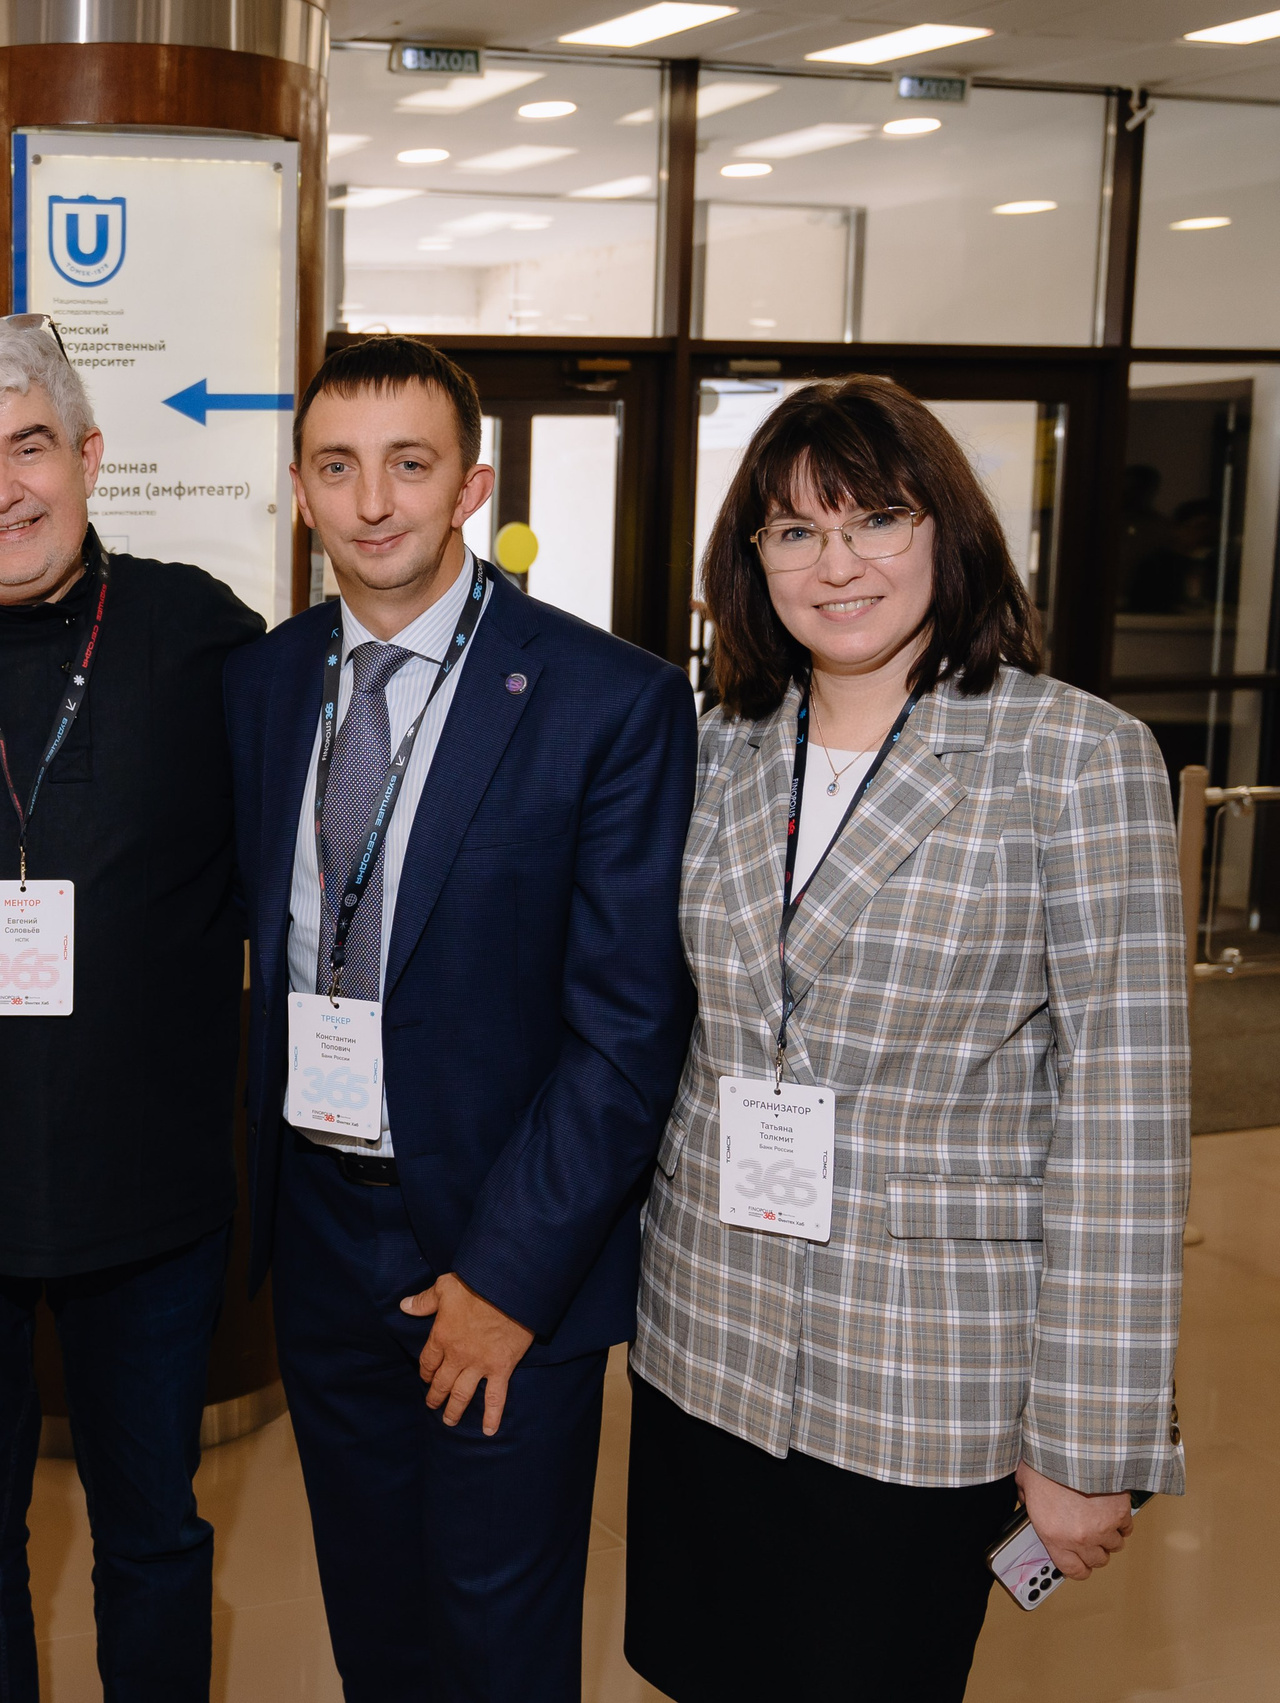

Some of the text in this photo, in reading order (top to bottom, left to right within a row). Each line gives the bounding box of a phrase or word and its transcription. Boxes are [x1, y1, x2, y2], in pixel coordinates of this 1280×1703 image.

[66, 213, 108, 266] U
[62, 340, 166, 353] осударственный
[70, 358, 136, 369] иверситет
[99, 463, 158, 474] ионная
[92, 482, 251, 501] тория (амфитеатр)
[473, 582, 482, 600] 365
[81, 624, 99, 669] СЕГОДНЯ
[322, 702, 334, 761] FINOPOLIS 365
[45, 717, 68, 762] БУДУЩЕЕ
[789, 777, 799, 818] FINOPOLIS
[355, 775, 397, 885] БУДУЩЕЕ СЕГОДНЯ
[4, 899, 41, 907] МЕНТОР
[4, 926, 40, 934] Соловьёв
[321, 1014, 351, 1025] ТРЕКЕР
[315, 1032, 357, 1044] Константин
[321, 1042, 351, 1053] Попович
[301, 1066, 369, 1111] 365
[743, 1099, 811, 1115] ОРГАНИЗАТОР
[760, 1121, 793, 1133] Татьяна
[759, 1131, 794, 1144] Толкмит
[774, 1145, 794, 1153] России
[735, 1158, 818, 1208] 365
